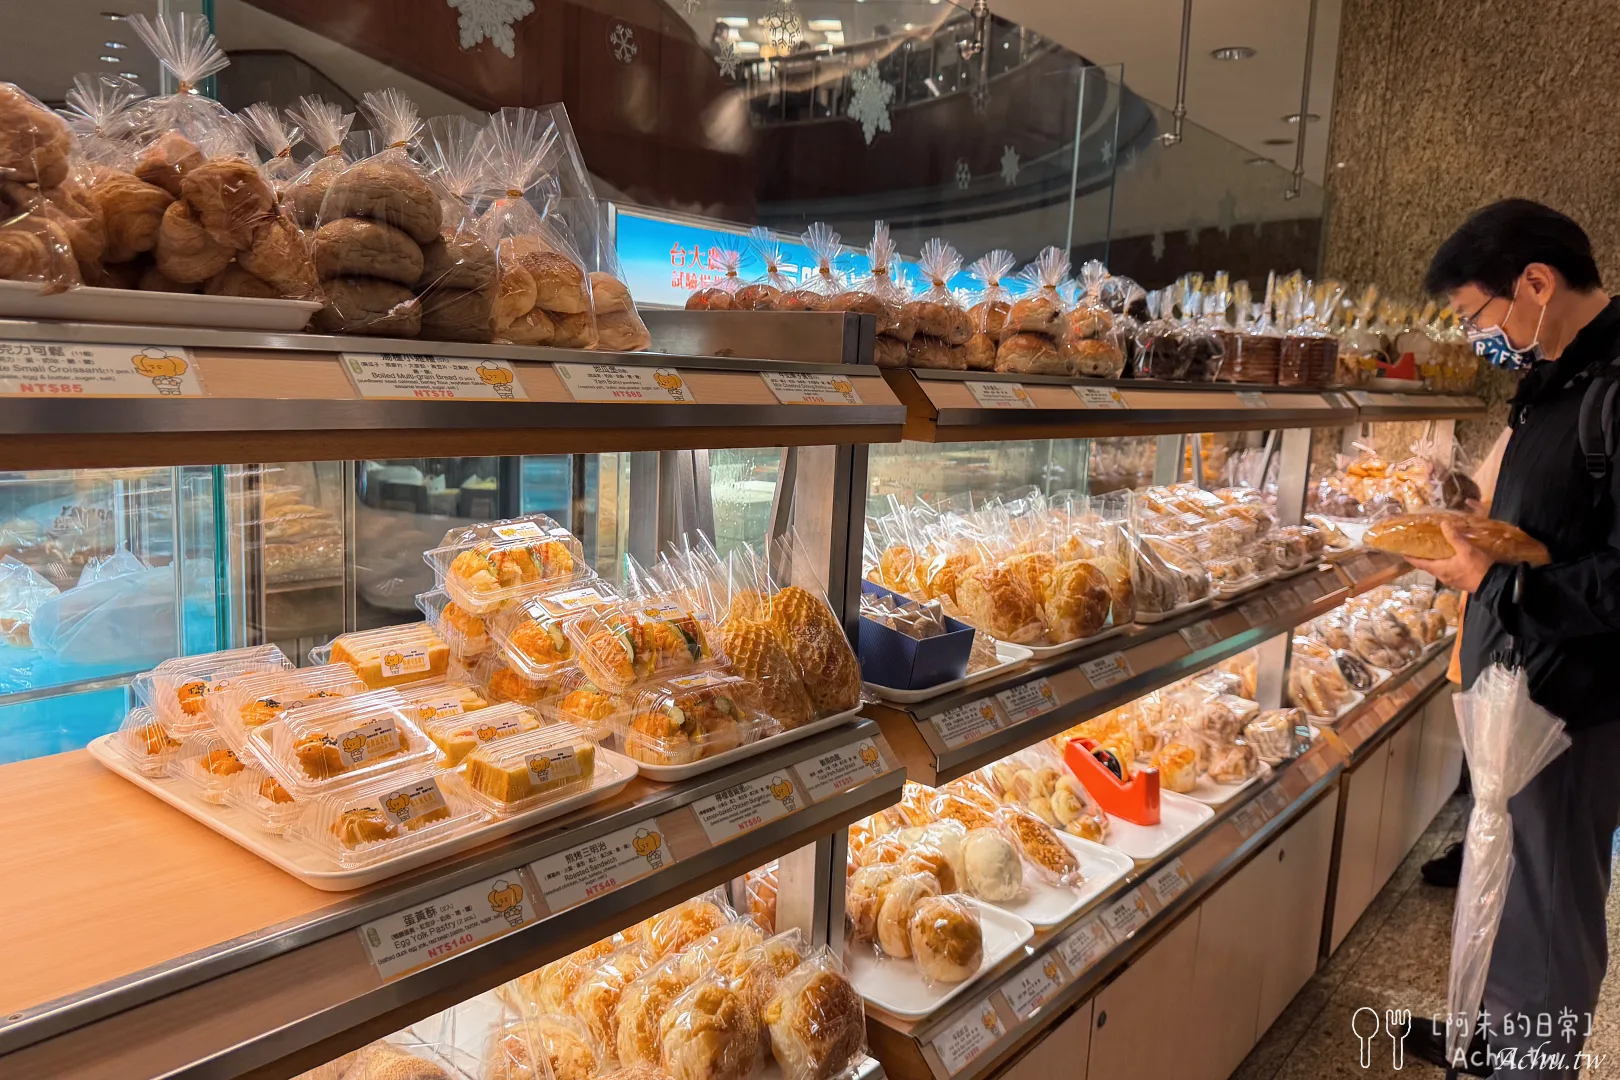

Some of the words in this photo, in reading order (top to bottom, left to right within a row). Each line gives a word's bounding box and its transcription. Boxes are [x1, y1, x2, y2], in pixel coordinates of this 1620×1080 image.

[396, 373, 435, 381] Multi-grain
[21, 384, 83, 393] NT$85
[414, 390, 454, 398] NT$78
[564, 868, 589, 881] Roasted
[589, 857, 617, 871] Sandwich
[586, 878, 616, 896] NT$48
[403, 906, 437, 926] 蛋黃酥
[394, 939, 410, 949] Egg
[411, 932, 429, 942] Yolk
[429, 921, 455, 935] Pastry
[428, 934, 473, 957] NT$140
